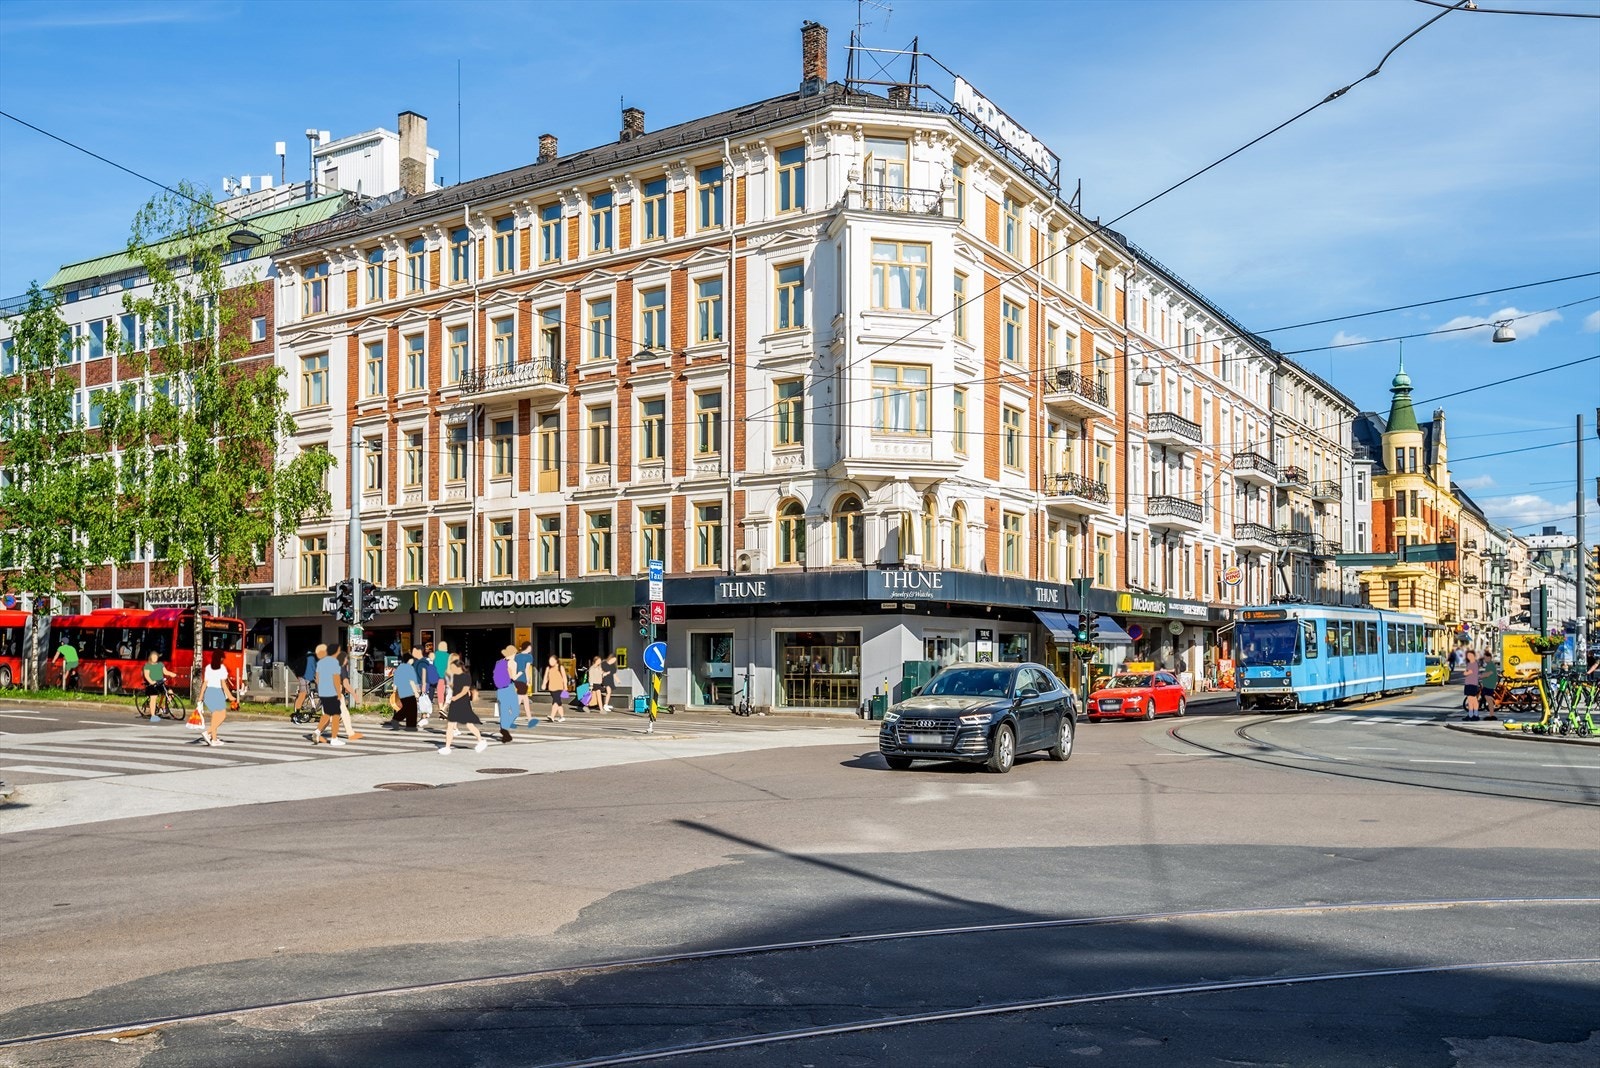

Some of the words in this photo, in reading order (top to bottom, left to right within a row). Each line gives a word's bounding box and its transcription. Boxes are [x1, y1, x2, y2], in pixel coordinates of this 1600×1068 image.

[881, 571, 943, 589] THUNE
[1225, 574, 1240, 582] KING
[480, 588, 573, 608] McDonald's
[719, 581, 767, 598] THUNE
[1035, 587, 1059, 603] THUNE
[1133, 597, 1166, 614] McDonald's
[1260, 670, 1272, 678] 135
